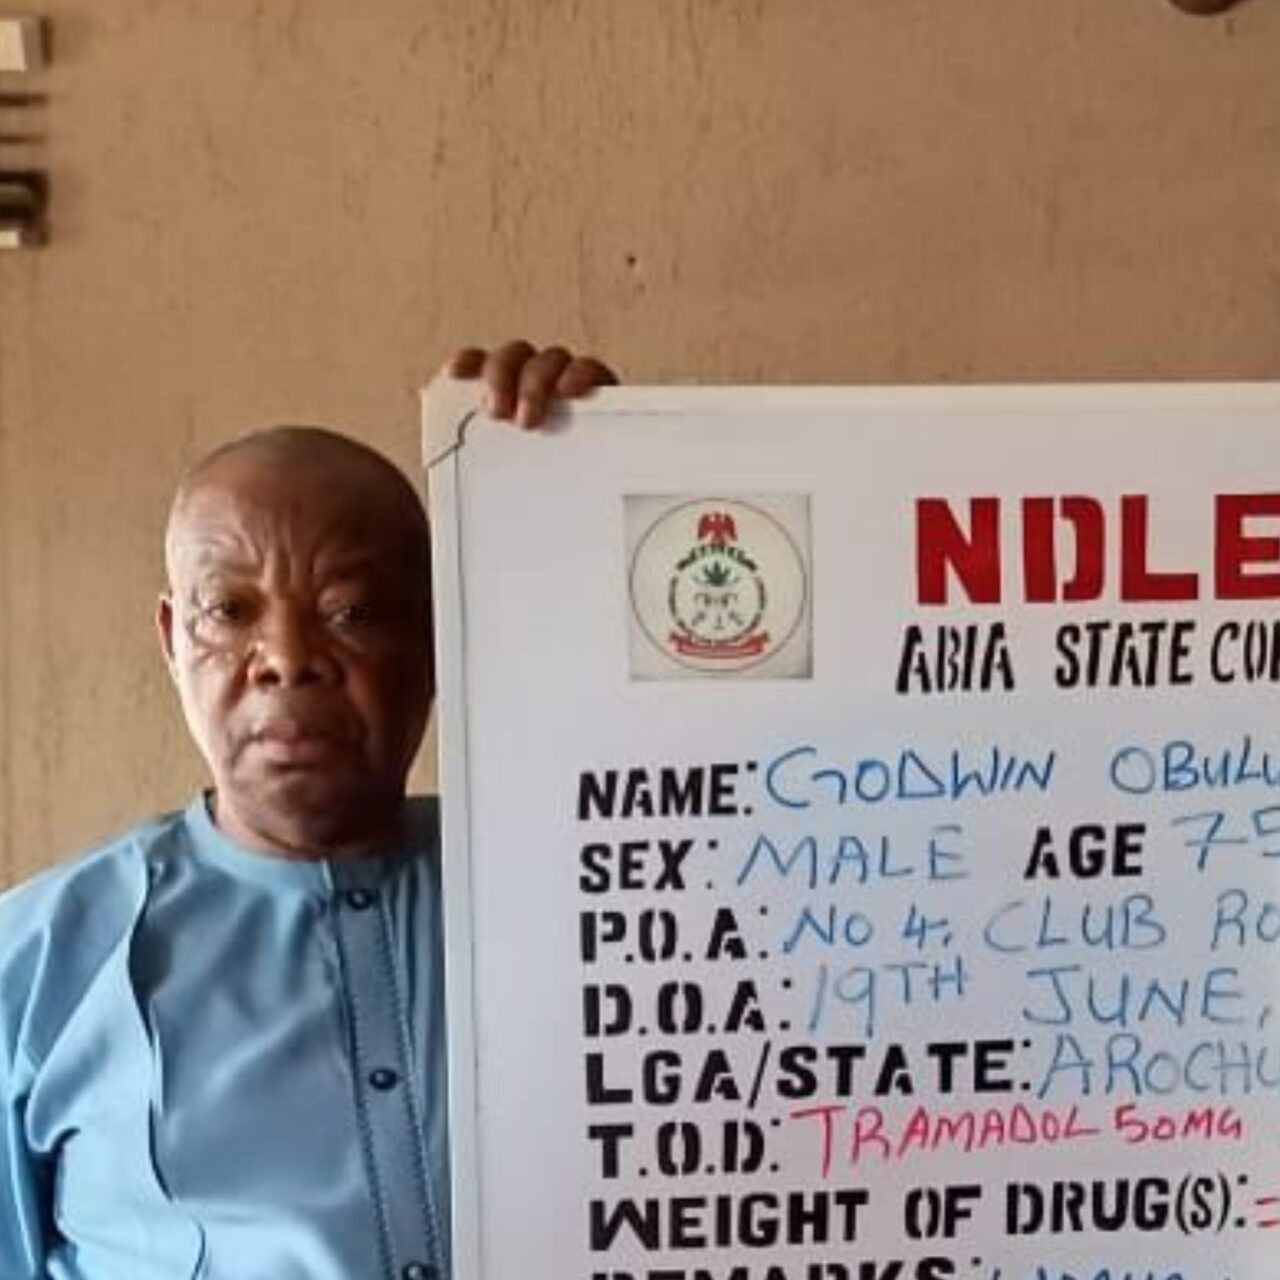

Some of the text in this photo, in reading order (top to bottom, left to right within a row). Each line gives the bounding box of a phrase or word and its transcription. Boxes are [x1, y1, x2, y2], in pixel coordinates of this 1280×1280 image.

[915, 493, 1280, 605] NDLE
[896, 622, 1014, 693] ABIA
[1055, 621, 1195, 688] STATE
[578, 761, 758, 820] NAME:
[765, 747, 1055, 807] GODWIN
[580, 838, 718, 893] SEX:
[736, 825, 969, 890] MALE
[1023, 823, 1146, 879] AGE
[580, 904, 769, 963] P.O.A:
[983, 893, 1166, 953] CLUB
[583, 957, 1271, 1037] D.O.A: 19TH JUNE,
[585, 1038, 1031, 1109] LGA/STATE:
[588, 1103, 1242, 1178] T.O.D: TRAMADOL 50MG
[589, 1190, 869, 1251] WEIGHT
[904, 1185, 982, 1239] OF
[1006, 1172, 1248, 1235] DRUG(S):
